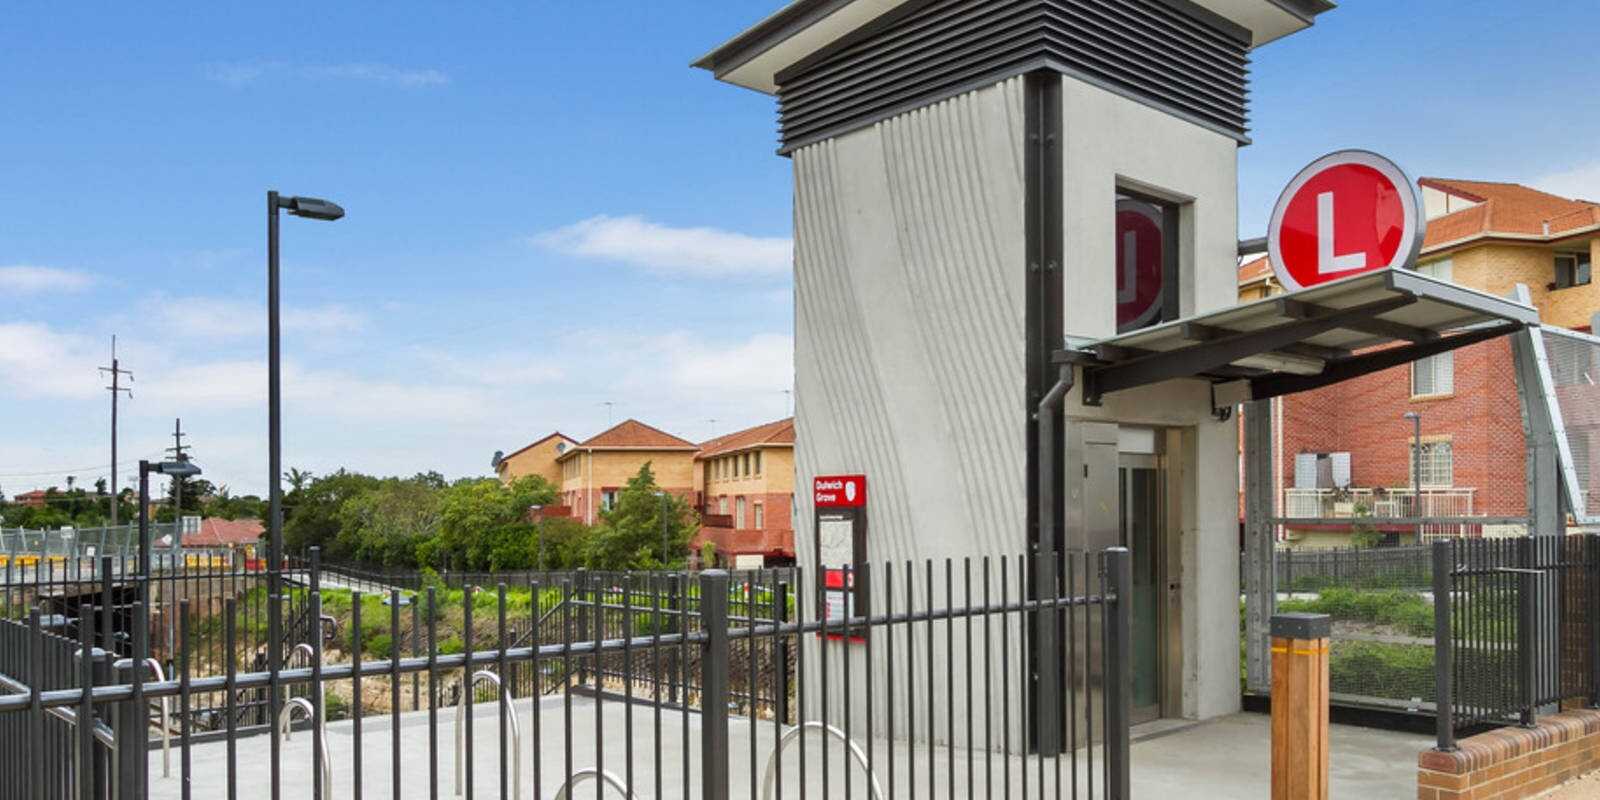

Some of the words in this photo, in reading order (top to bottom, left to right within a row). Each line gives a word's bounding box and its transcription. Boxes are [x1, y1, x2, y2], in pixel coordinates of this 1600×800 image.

[1316, 191, 1367, 275] L
[815, 480, 842, 490] Dulwich
[815, 493, 836, 502] Grove
